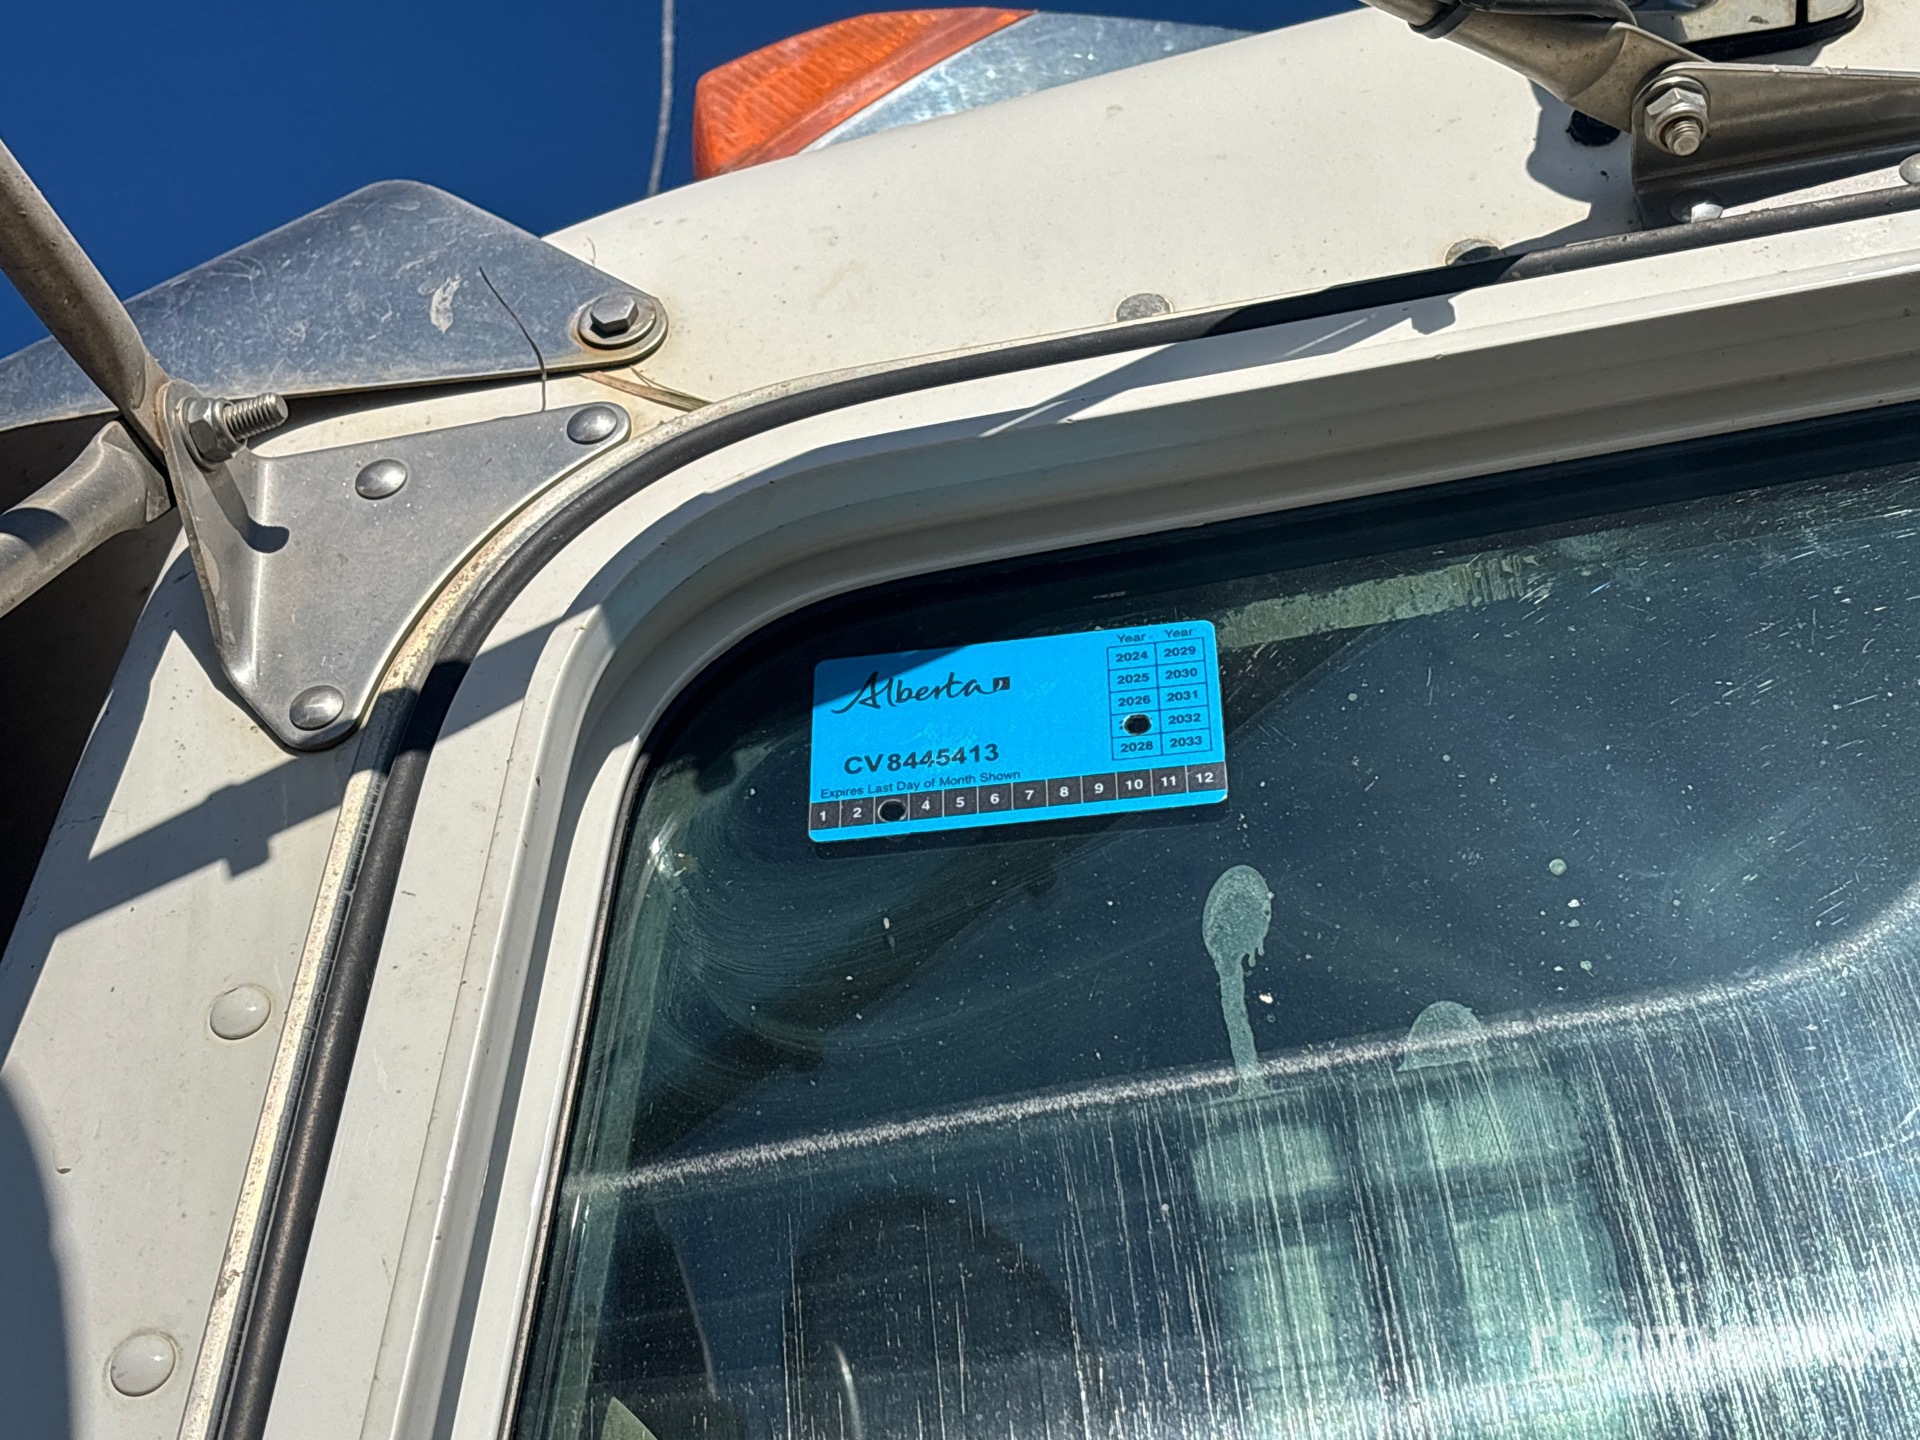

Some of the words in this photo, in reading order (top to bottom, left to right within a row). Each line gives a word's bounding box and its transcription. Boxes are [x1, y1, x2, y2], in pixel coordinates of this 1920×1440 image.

[1117, 633, 1146, 644] Year
[1164, 628, 1193, 639] Year
[1115, 650, 1149, 663] 2024
[1163, 645, 1196, 658] 2029
[1116, 673, 1150, 685] 2025
[1165, 667, 1198, 680] 2030
[830, 670, 1001, 714] Alberta
[1117, 695, 1151, 707] 2026
[1166, 690, 1199, 702] 2031
[1168, 712, 1201, 725] 2032
[1119, 740, 1153, 753] 2028
[1169, 735, 1203, 748] 2033
[820, 785, 864, 800] Expires
[867, 781, 893, 794] Last
[896, 777, 920, 792] Day
[924, 775, 938, 788] of
[939, 773, 976, 787] Month
[980, 769, 1021, 784] Shown
[819, 810, 827, 821] 1
[852, 807, 862, 818] 2
[921, 800, 931, 811] 4
[955, 796, 965, 808] 5
[990, 793, 1000, 804] 6
[1024, 790, 1034, 800] 7
[1059, 787, 1069, 797] 8
[1094, 783, 1104, 794] 9
[1125, 779, 1144, 790] 10
[1160, 775, 1176, 787] 11
[1195, 772, 1214, 783] 12
